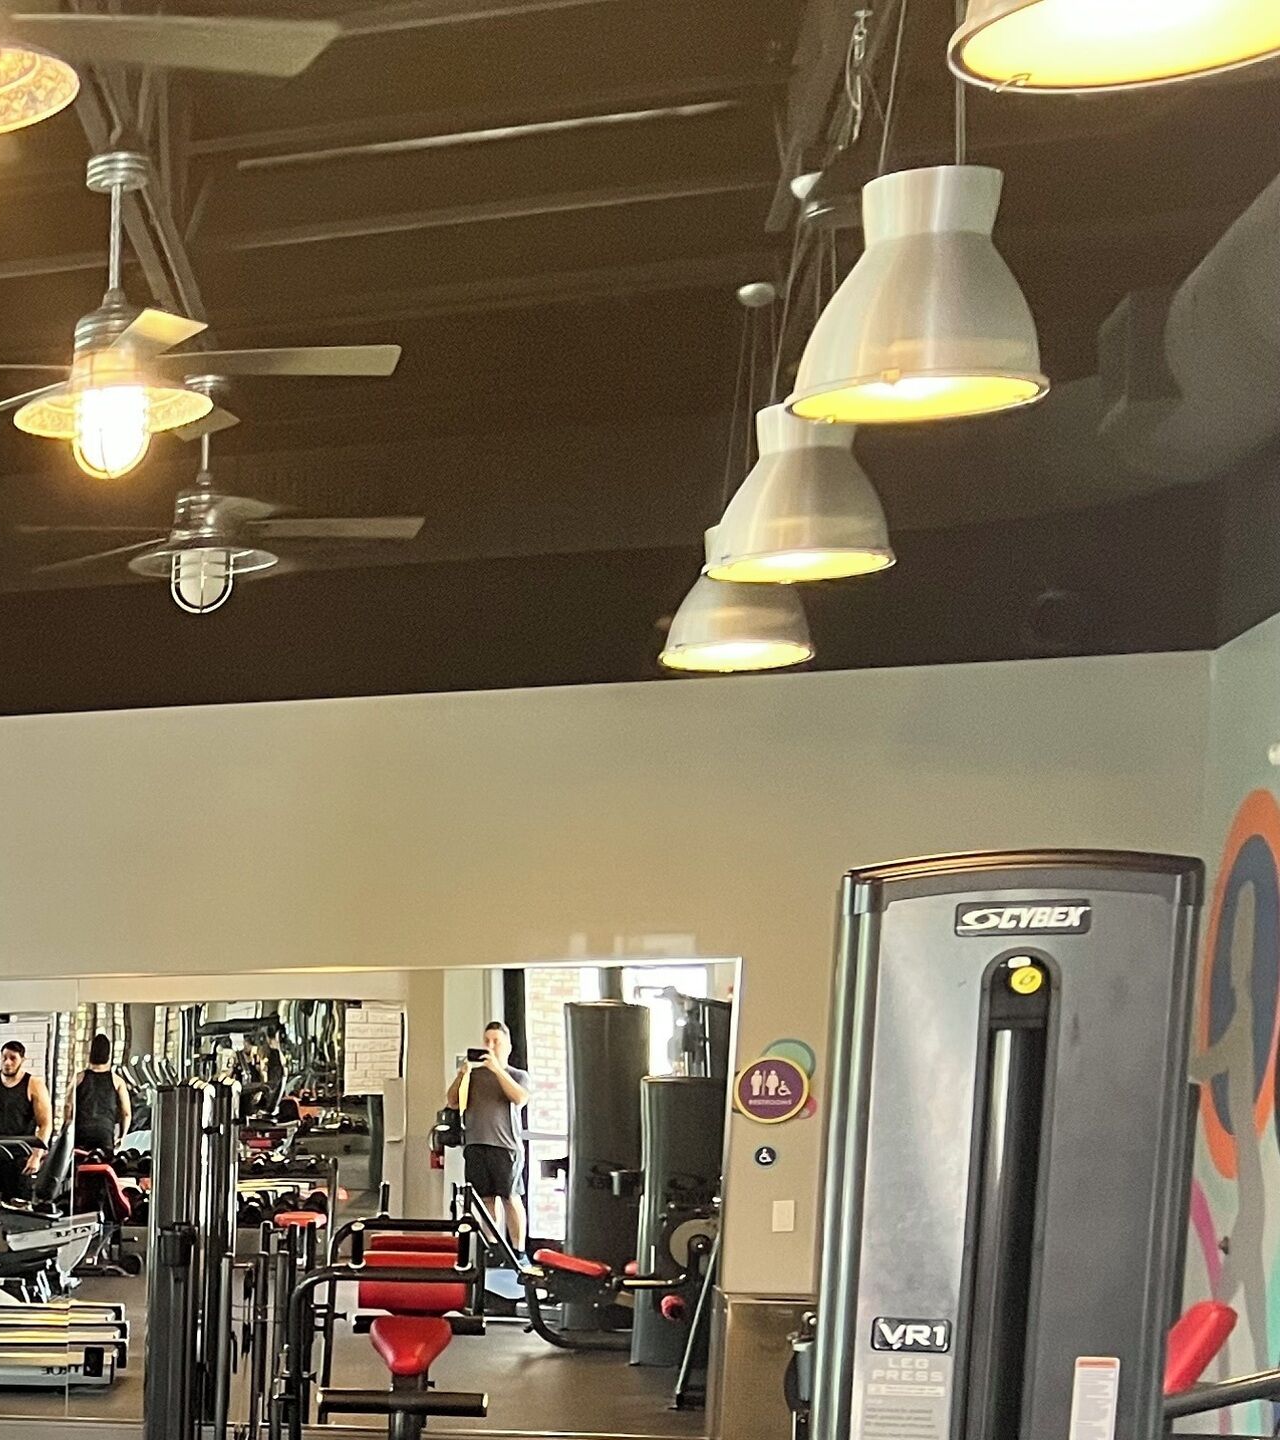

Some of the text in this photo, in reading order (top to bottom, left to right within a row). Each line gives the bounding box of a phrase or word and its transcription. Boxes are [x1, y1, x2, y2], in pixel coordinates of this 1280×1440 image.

[997, 906, 1091, 929] CYBEX
[878, 1324, 947, 1347] VR1
[888, 1357, 930, 1370] LEG
[872, 1369, 945, 1382] PRESS
